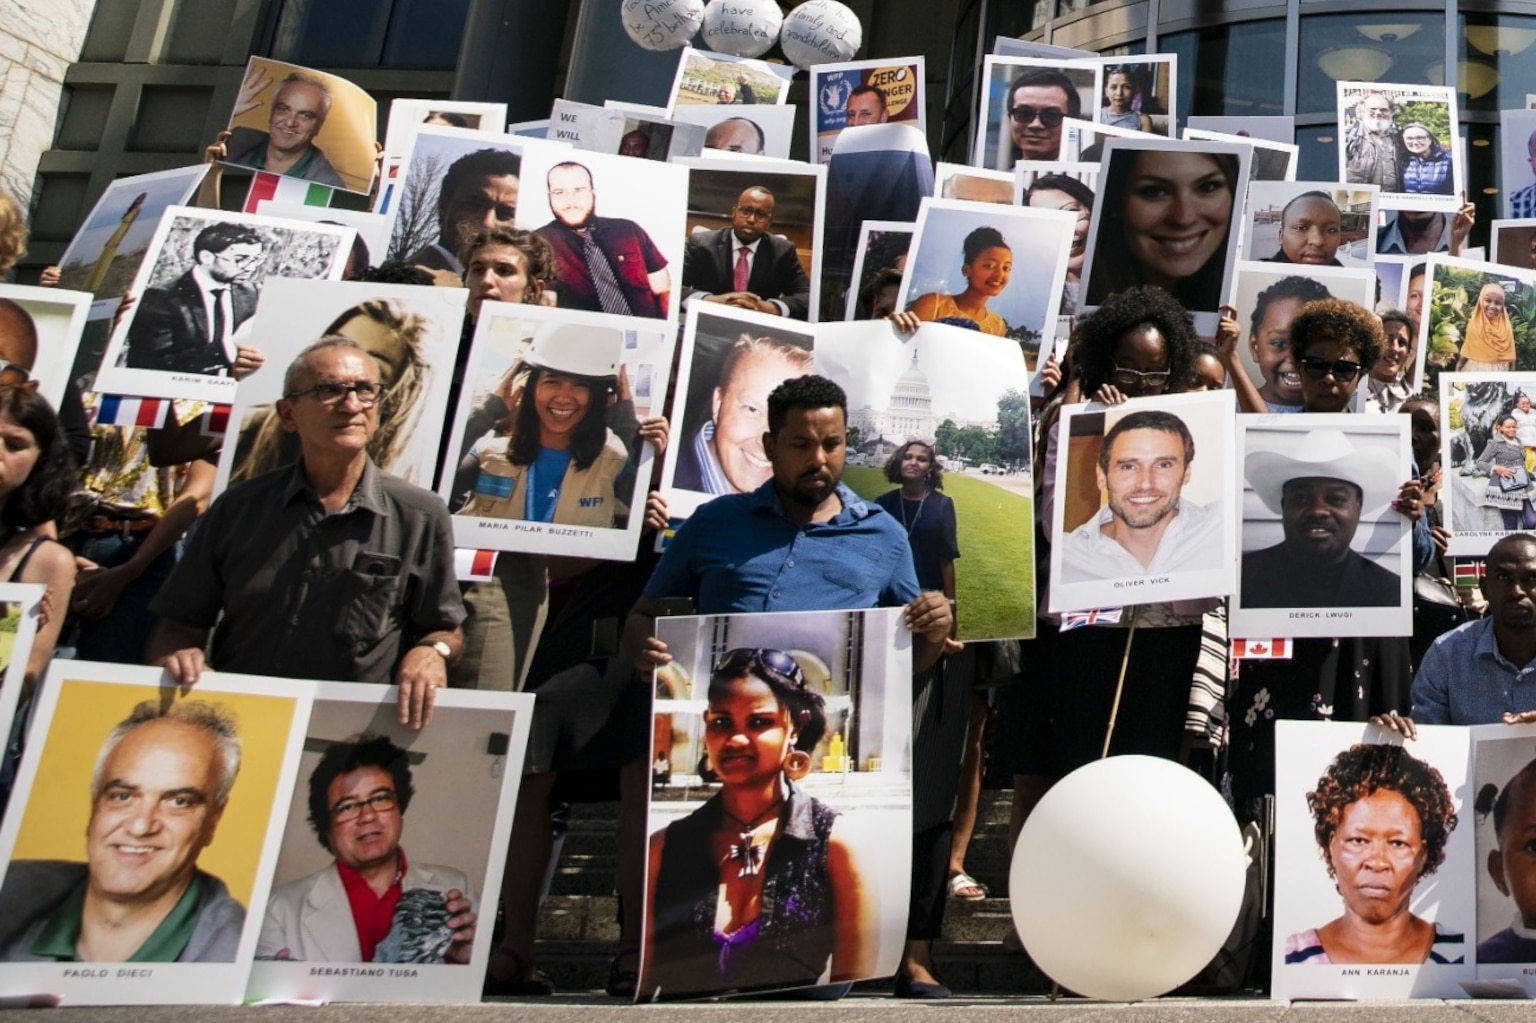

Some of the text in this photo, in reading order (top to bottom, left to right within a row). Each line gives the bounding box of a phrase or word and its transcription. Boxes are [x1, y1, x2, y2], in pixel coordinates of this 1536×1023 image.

[720, 2, 754, 15] have
[707, 19, 769, 38] celebrated
[793, 5, 846, 41] family and
[784, 29, 841, 61] grandchildren
[873, 68, 906, 86] ZERO
[884, 84, 913, 97] NGER
[560, 112, 578, 123] WE
[556, 129, 581, 141] WILL
[171, 376, 202, 384] KARIM
[479, 521, 593, 537] MARIA PILAR BUZZETTI
[1113, 577, 1170, 588] OLIVER VICK
[63, 969, 153, 977] PAOLO DIECI
[310, 967, 418, 977] SEBASTIANO TUSA
